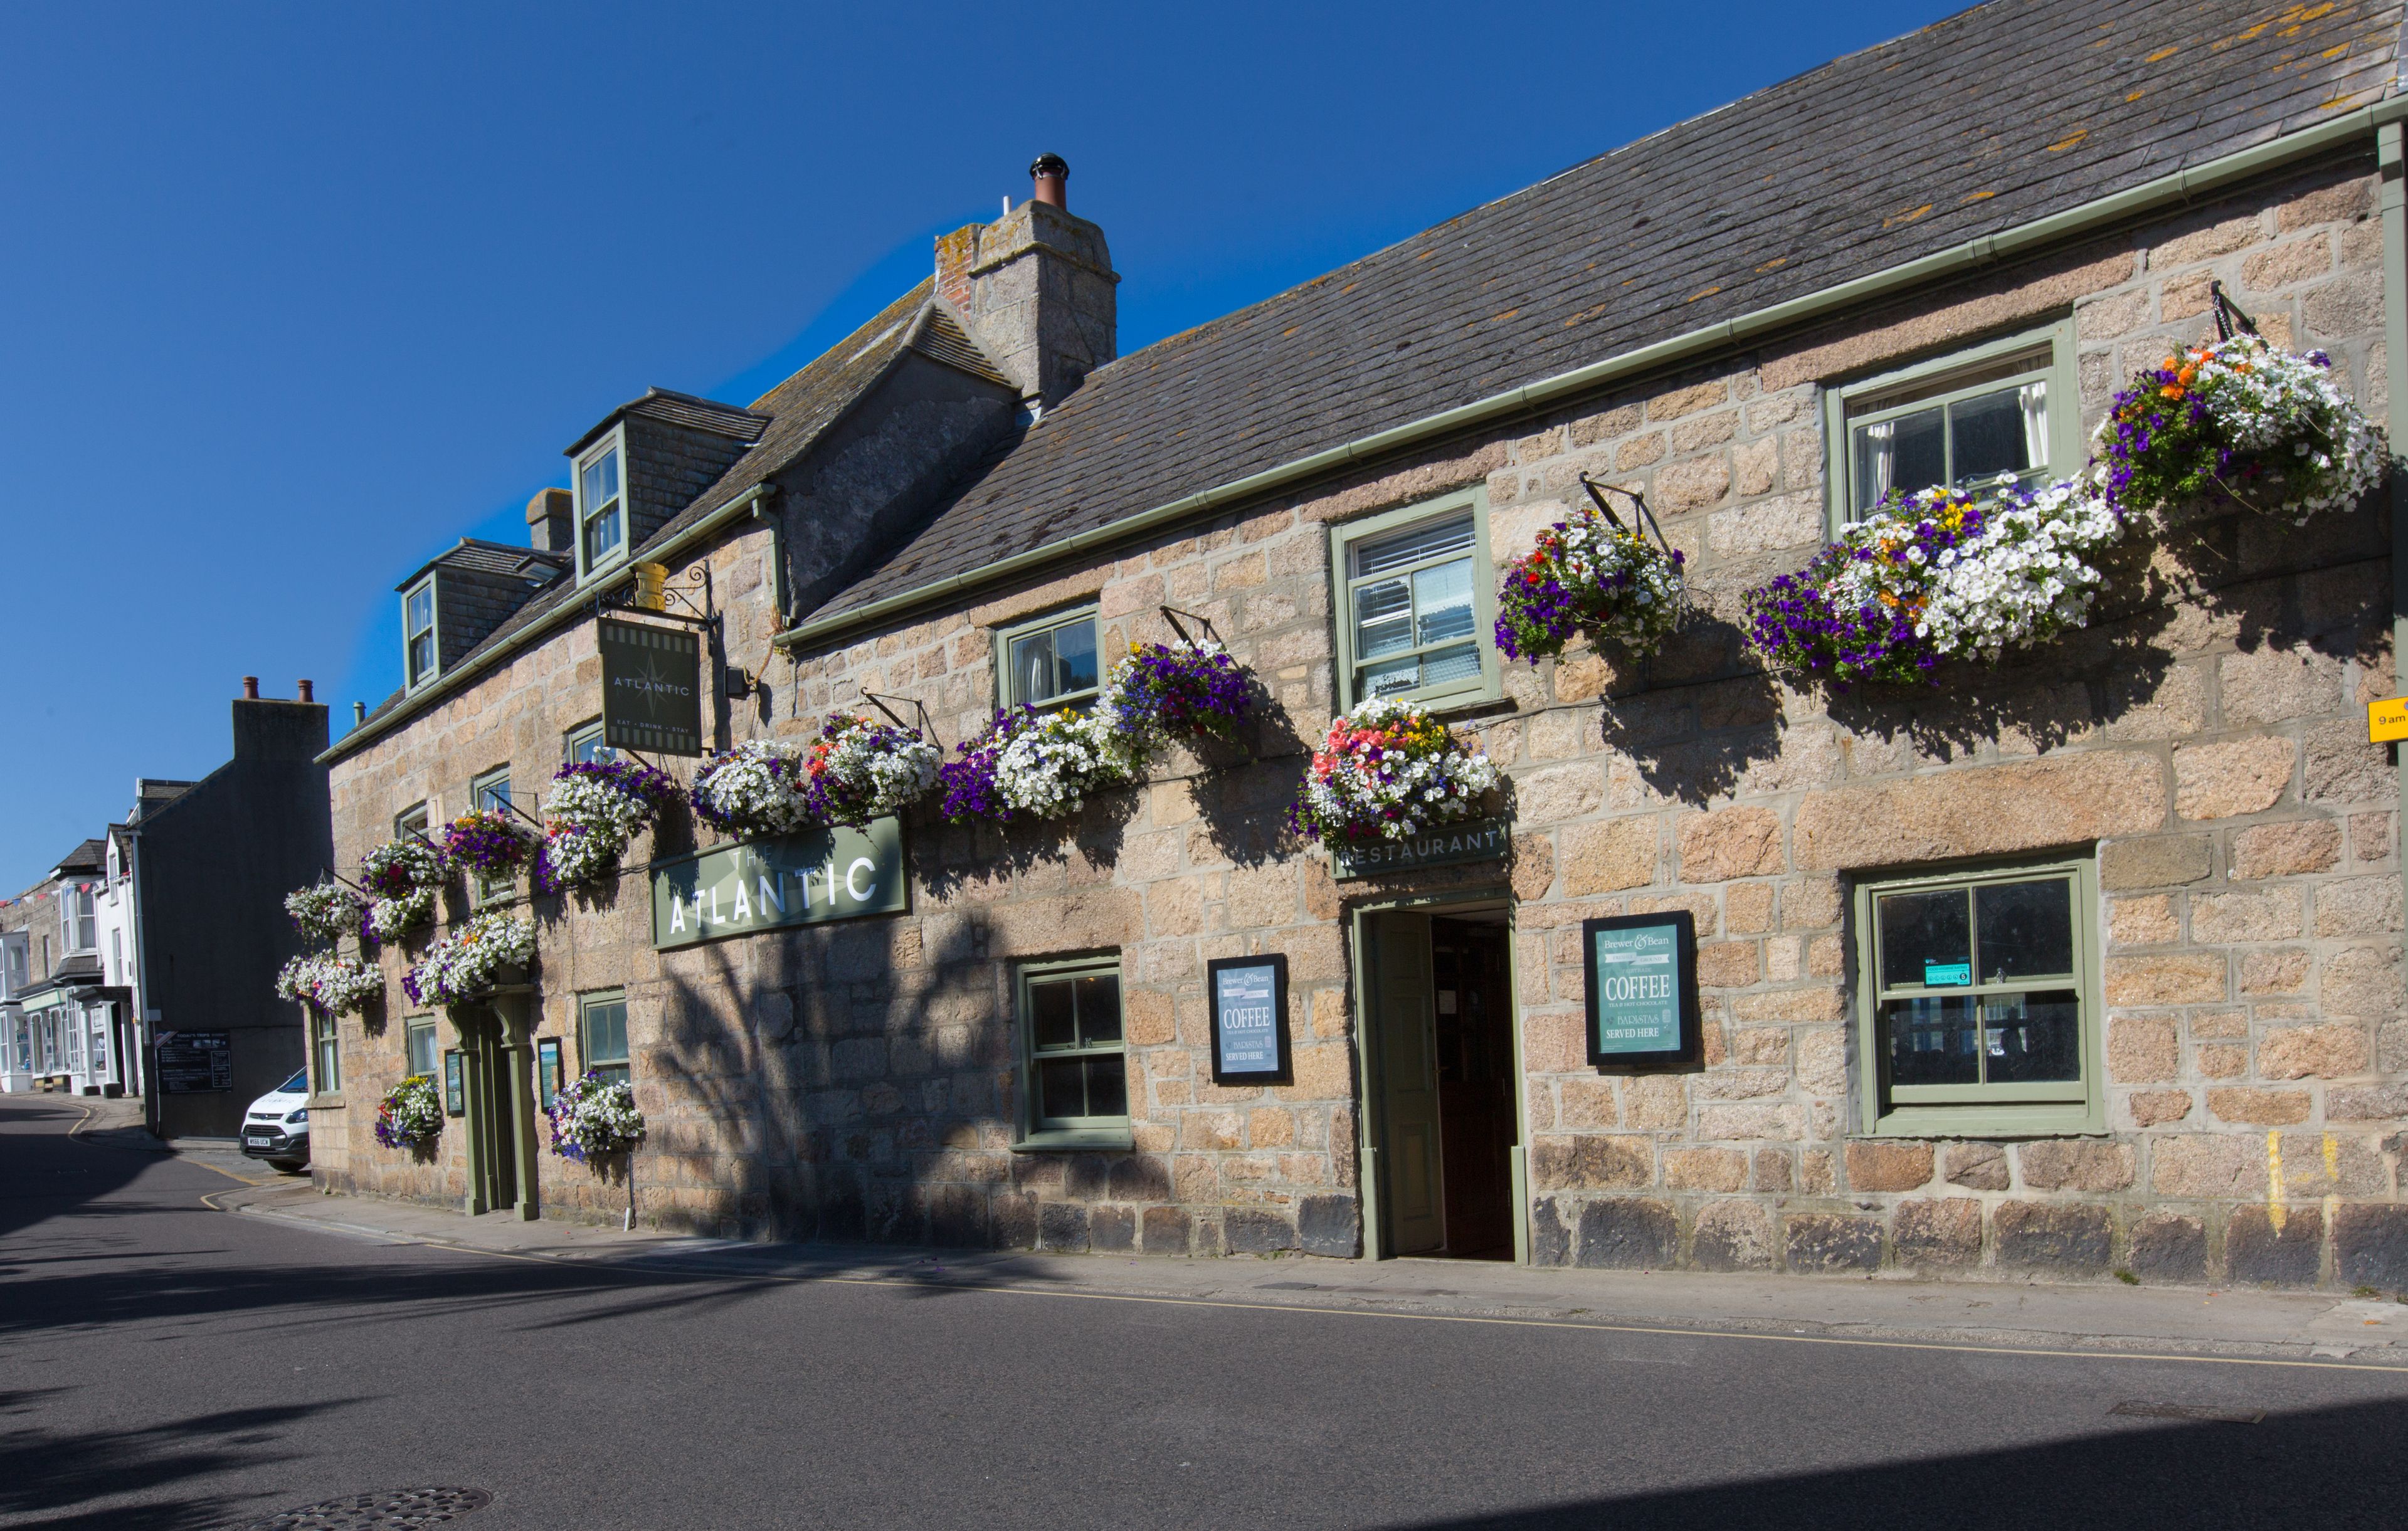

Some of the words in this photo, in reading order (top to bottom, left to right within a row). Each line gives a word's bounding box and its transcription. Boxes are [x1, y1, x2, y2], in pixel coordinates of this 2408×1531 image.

[614, 676, 690, 697] ATLANTIC
[640, 722, 662, 730] DRINK
[2379, 716, 2387, 725] 9
[2389, 715, 2405, 724] am
[1340, 830, 1497, 866] RESTAURANT
[732, 844, 773, 870] THE
[669, 856, 878, 935] ATLANTIC
[1605, 940, 1634, 949] Brewer
[1634, 934, 1648, 950] &
[1647, 937, 1669, 945] Bean
[1223, 977, 1244, 986] Brewer
[1244, 972, 1254, 986] &
[1605, 974, 1671, 1001] COFFEE
[1223, 1007, 1270, 1029] COFFEE
[1617, 1014, 1660, 1025] BARISTAS
[1606, 1028, 1635, 1039] SERVED
[1637, 1028, 1659, 1038] HERE
[1233, 1040, 1264, 1050] BARISTAS
[1225, 1052, 1247, 1061] SERVED
[1248, 1051, 1264, 1060] HERE
